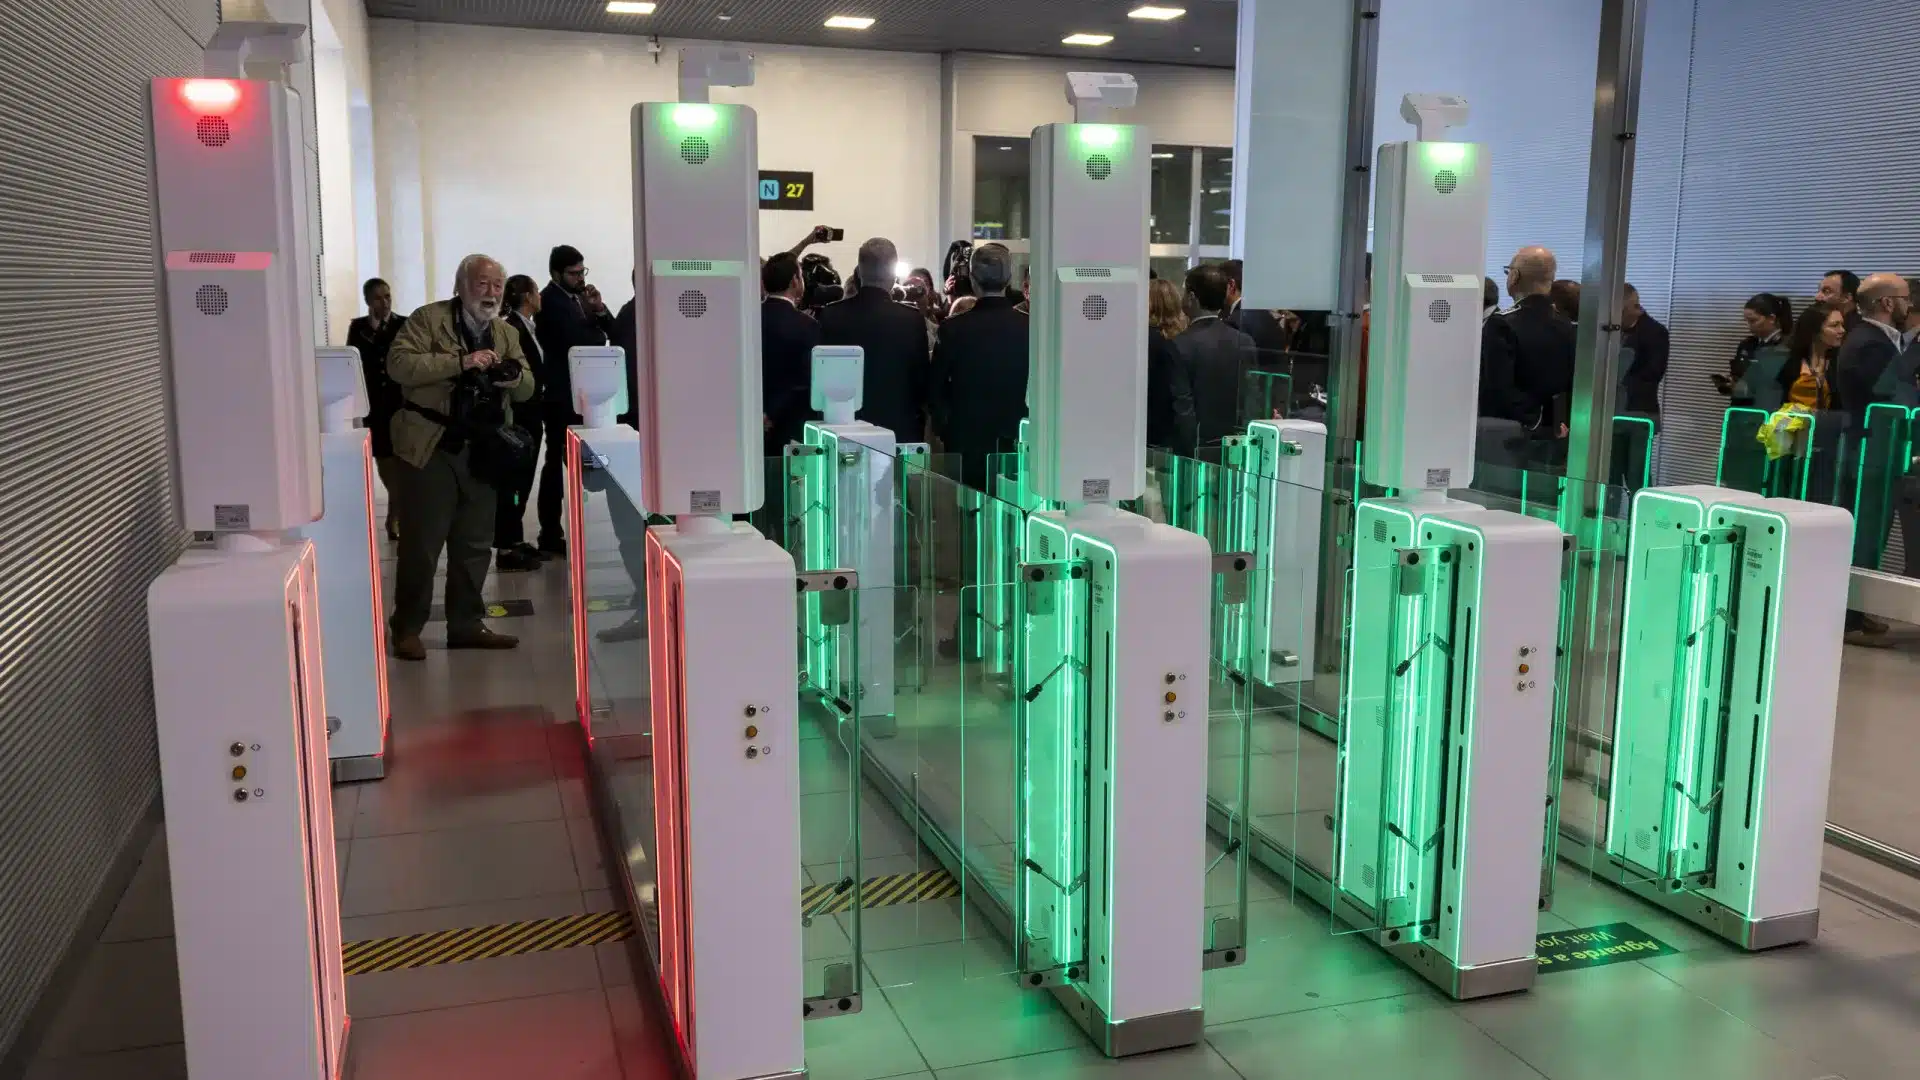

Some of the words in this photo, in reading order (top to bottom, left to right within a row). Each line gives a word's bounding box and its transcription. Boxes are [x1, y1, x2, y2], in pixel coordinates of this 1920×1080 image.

[764, 183, 775, 197] N
[786, 183, 805, 198] 27
[1565, 931, 1617, 944] Wait
[1571, 940, 1660, 960] Aguarde
[1553, 953, 1570, 962] a
